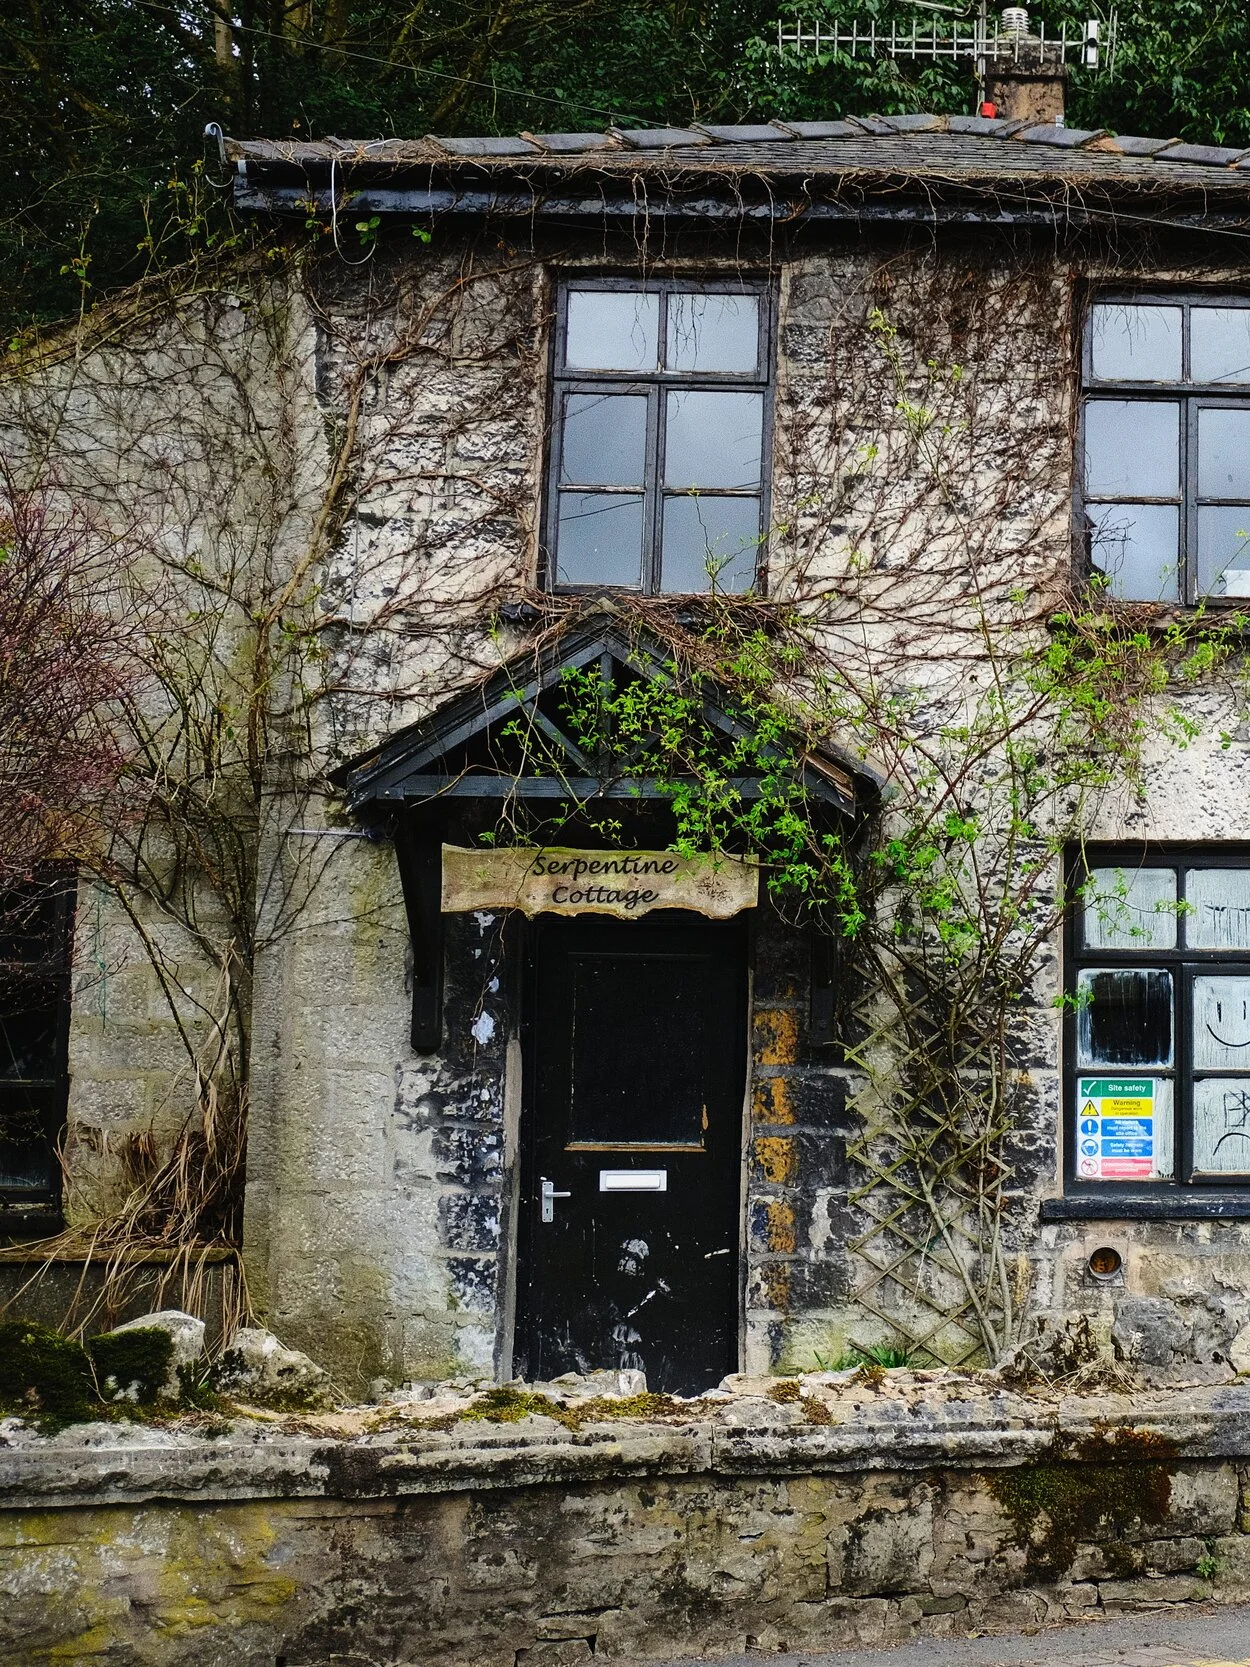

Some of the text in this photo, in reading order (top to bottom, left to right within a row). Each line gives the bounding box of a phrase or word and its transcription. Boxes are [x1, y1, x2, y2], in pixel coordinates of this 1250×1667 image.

[532, 856, 679, 881] Serpentine
[552, 886, 659, 909] Cottage
[1108, 1084, 1146, 1092] Site safety
[1113, 1099, 1140, 1107] Warning
